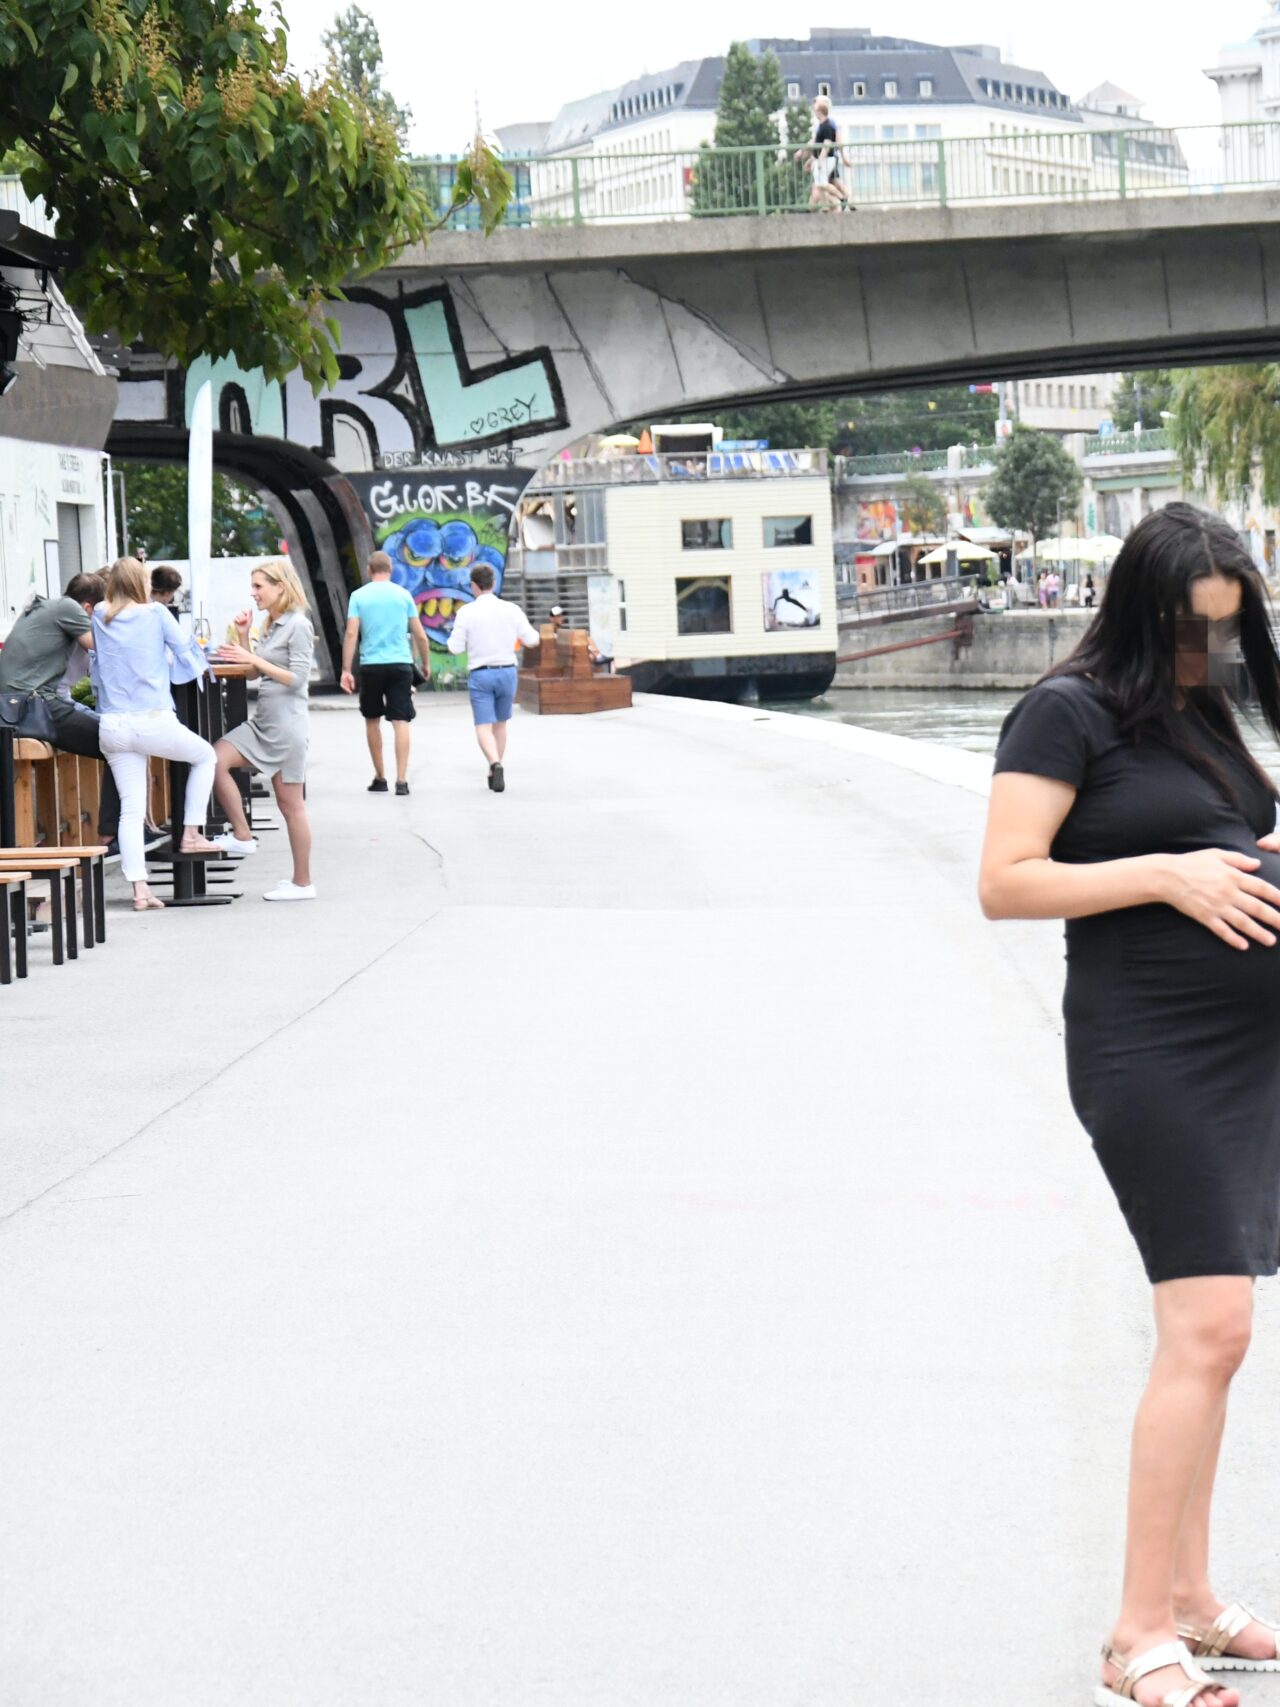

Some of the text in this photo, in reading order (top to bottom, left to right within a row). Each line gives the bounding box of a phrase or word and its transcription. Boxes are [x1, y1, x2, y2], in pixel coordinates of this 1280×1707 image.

[486, 393, 537, 428] GREY
[382, 447, 523, 467] DER KNAST HAT
